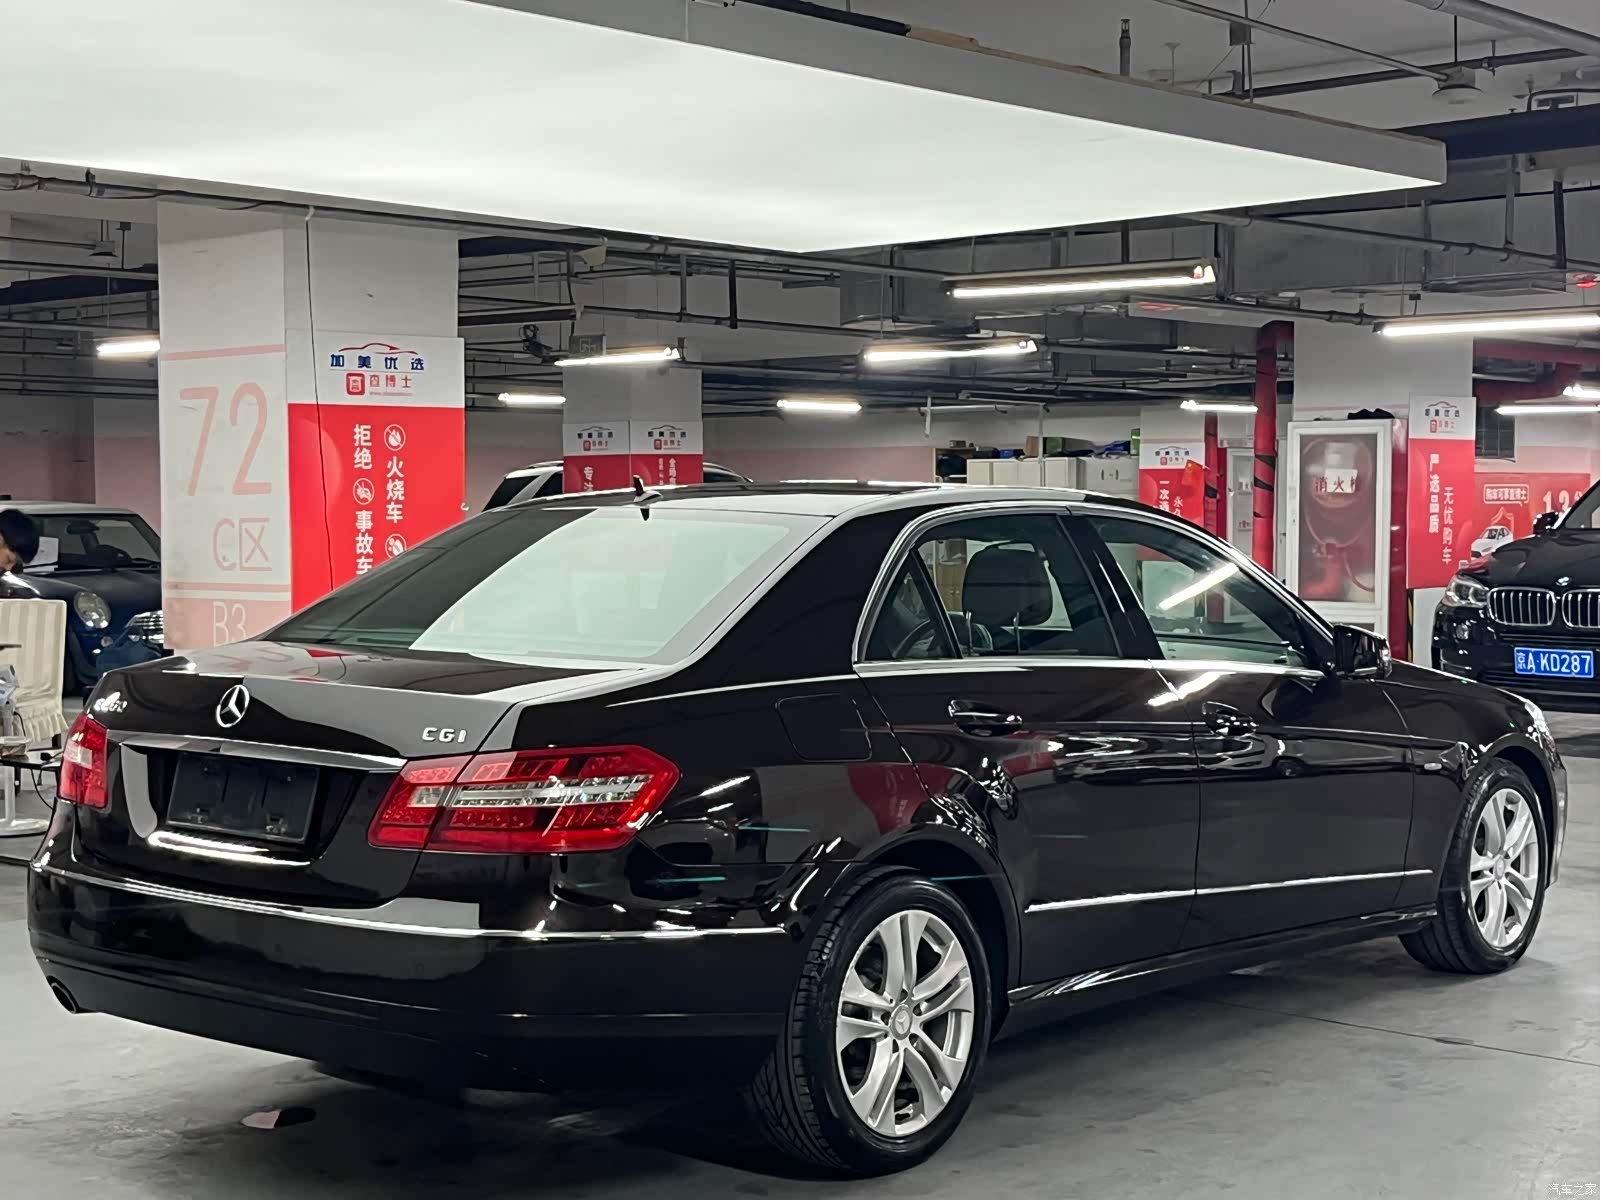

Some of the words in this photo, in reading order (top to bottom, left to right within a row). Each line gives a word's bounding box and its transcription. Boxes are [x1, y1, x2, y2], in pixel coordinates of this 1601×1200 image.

[330, 353, 425, 371] 加美优选
[179, 382, 272, 496] 72
[353, 423, 373, 470] 拒绝
[386, 455, 405, 524] 火烧车
[213, 517, 272, 572] C区
[355, 509, 374, 576] 事故车
[213, 601, 246, 648] B3
[422, 727, 467, 743] CGI
